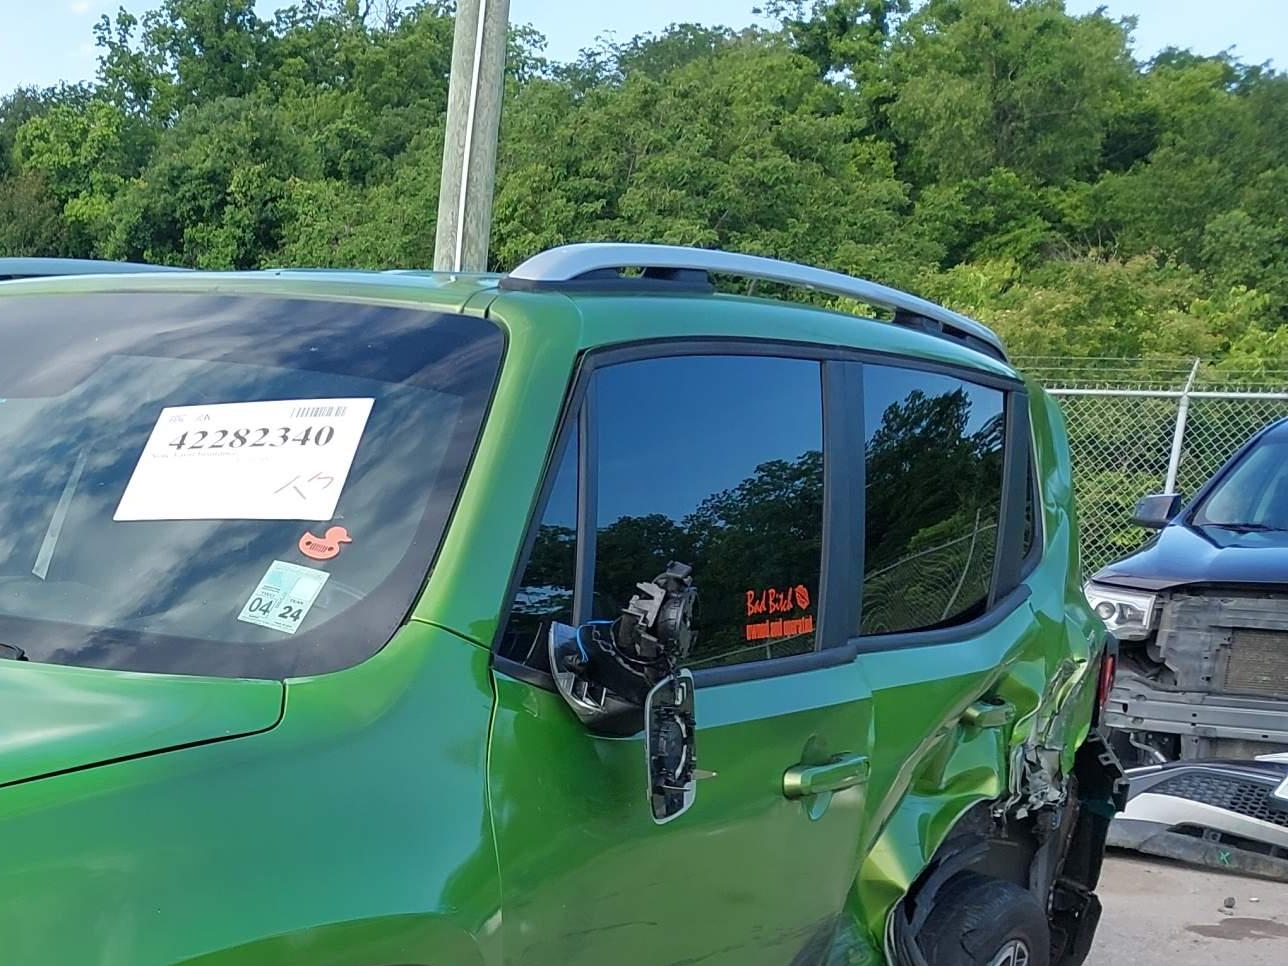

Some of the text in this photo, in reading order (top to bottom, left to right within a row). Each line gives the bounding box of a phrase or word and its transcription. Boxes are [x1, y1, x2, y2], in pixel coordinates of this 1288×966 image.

[168, 426, 335, 450] 42282340
[249, 598, 273, 616] 04
[279, 606, 303, 622] 24
[746, 587, 793, 616] Bad Bitch
